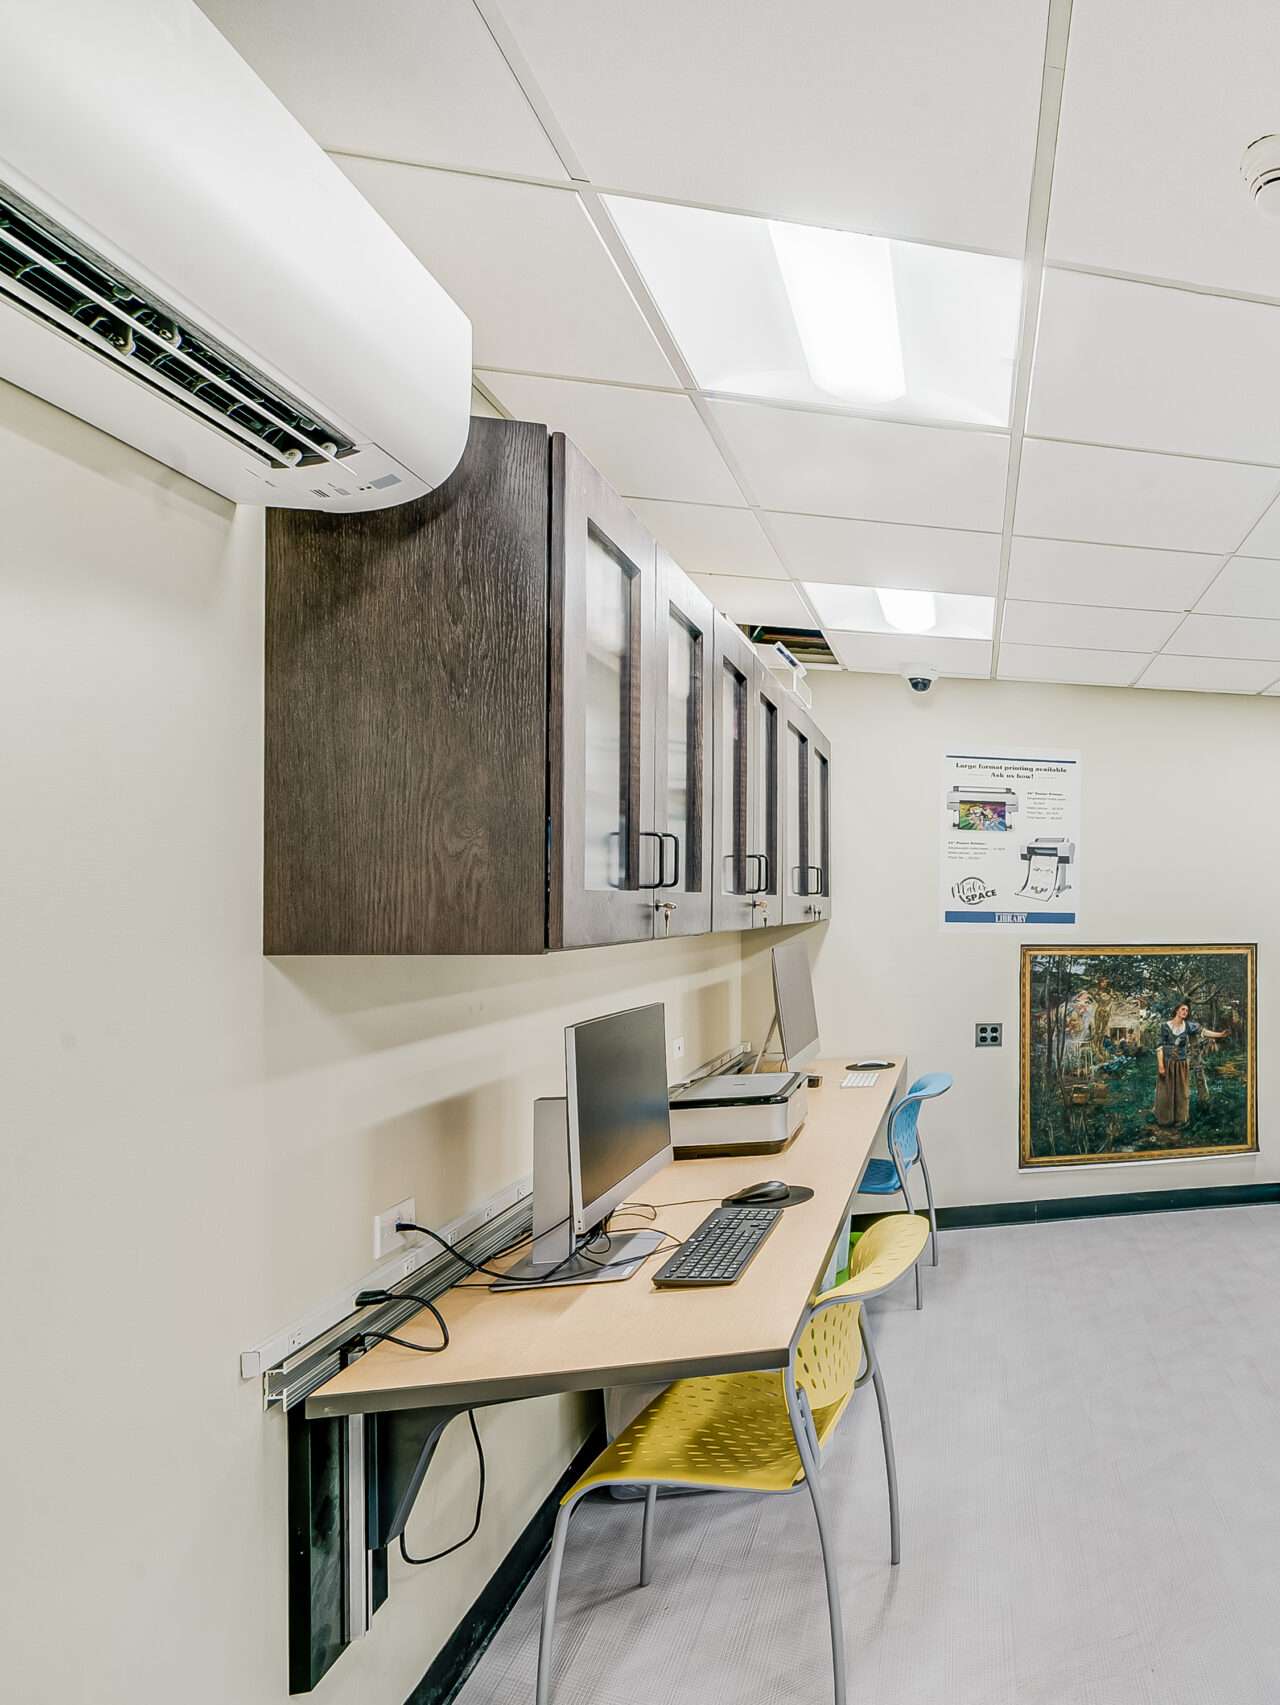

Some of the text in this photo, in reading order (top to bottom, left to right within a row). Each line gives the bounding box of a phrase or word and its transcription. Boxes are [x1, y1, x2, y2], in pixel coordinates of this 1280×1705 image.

[978, 763, 1003, 771] format
[1004, 764, 1033, 772] printing
[965, 889, 998, 903] SPACE
